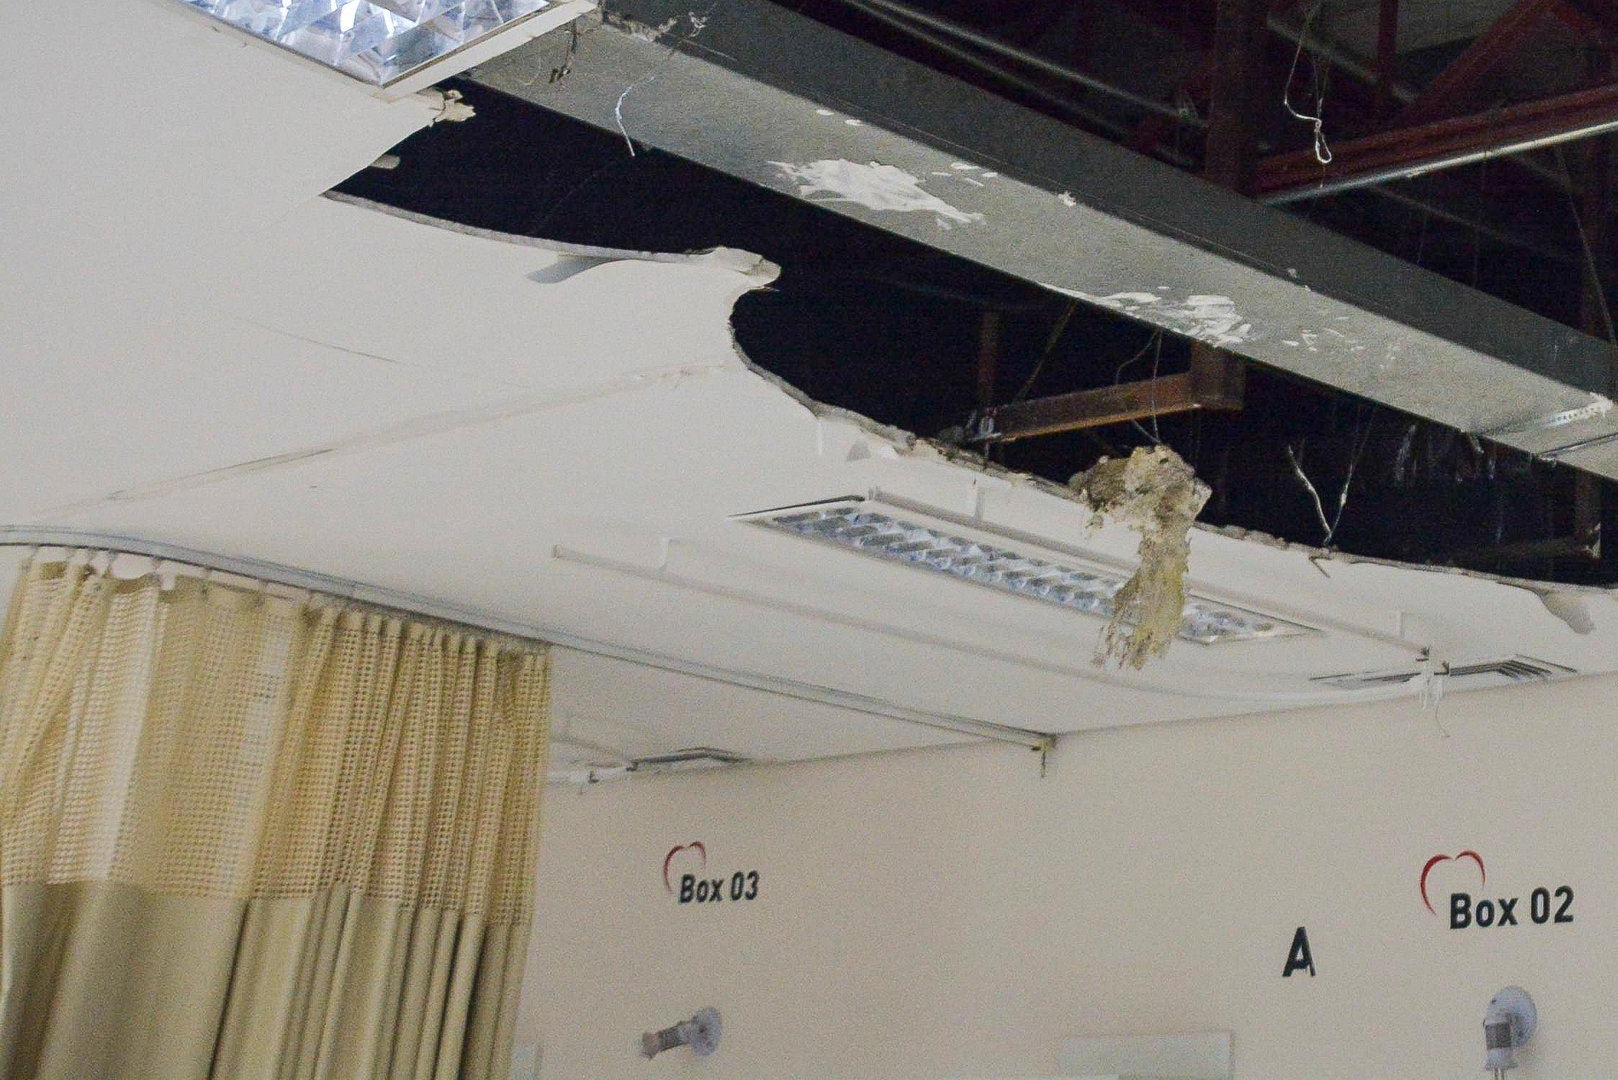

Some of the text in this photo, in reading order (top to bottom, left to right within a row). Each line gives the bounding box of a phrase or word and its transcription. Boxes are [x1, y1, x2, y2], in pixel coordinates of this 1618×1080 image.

[678, 869, 761, 905] Box 03
[1449, 885, 1575, 930] Box 02
[1281, 926, 1317, 978] A
